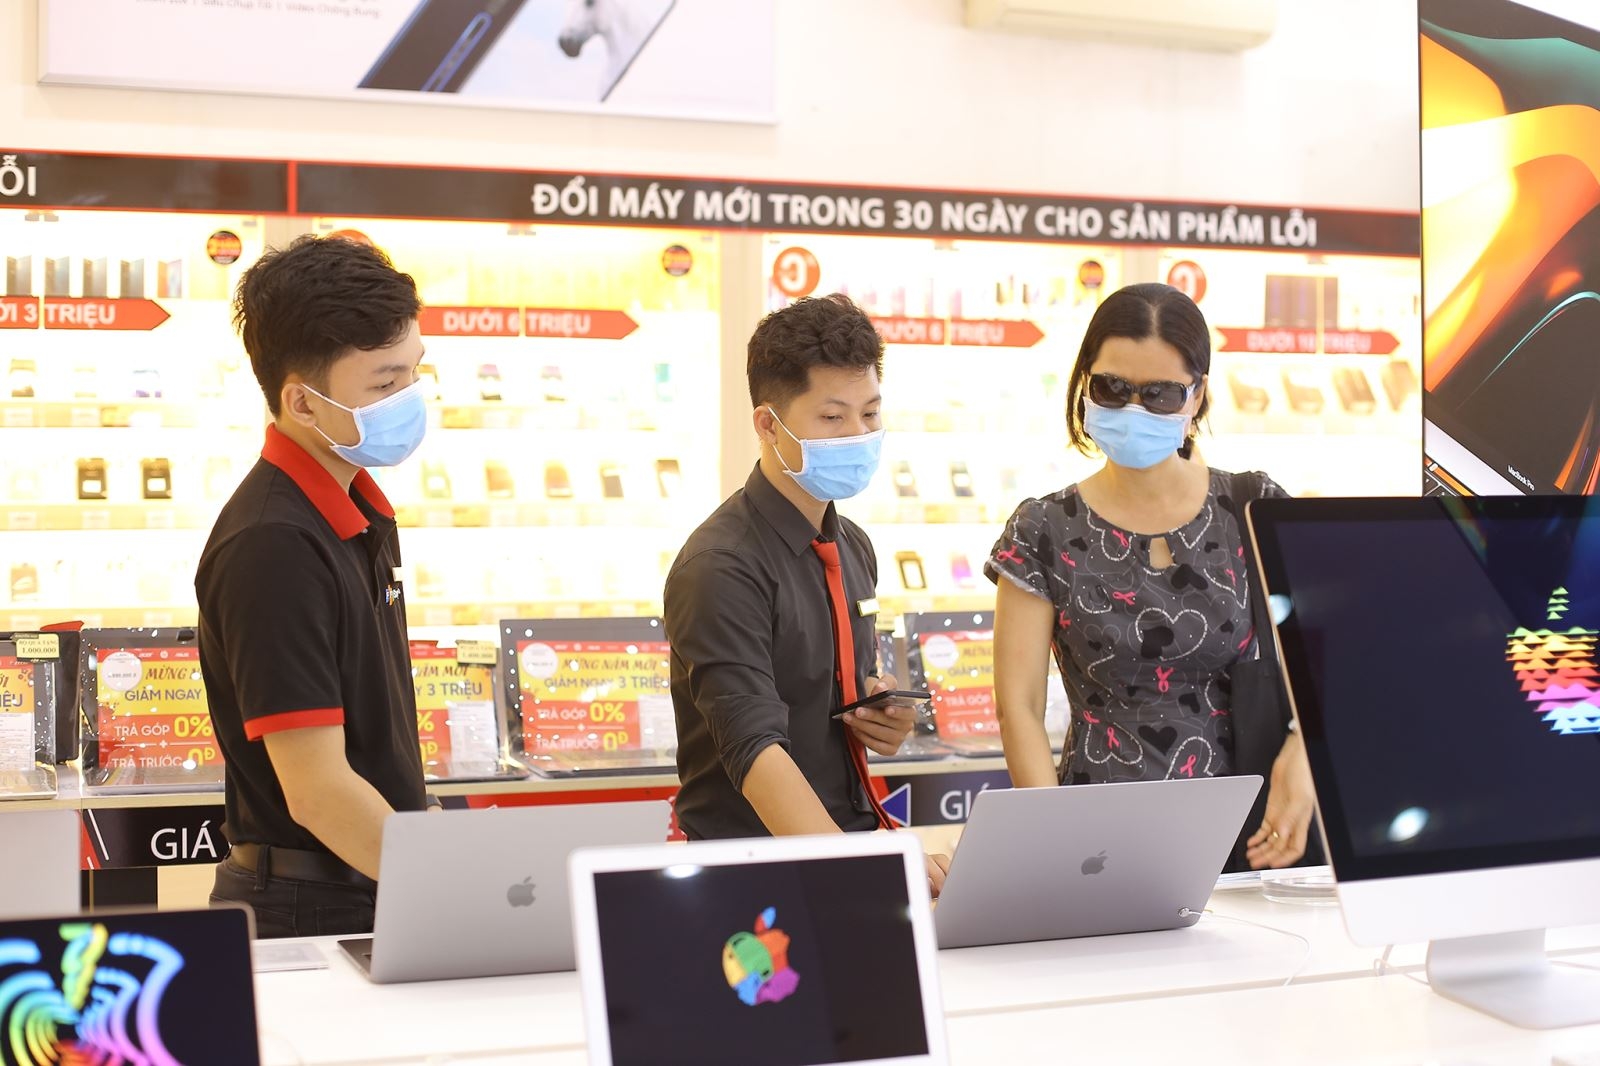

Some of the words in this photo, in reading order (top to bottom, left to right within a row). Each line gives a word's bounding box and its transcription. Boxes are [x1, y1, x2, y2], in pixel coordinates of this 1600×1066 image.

[0, 154, 37, 197] ỖI
[531, 174, 599, 217] ĐỔI
[608, 182, 685, 220] MÁY
[693, 185, 762, 223] MỚI
[767, 193, 886, 229] TRONG
[892, 199, 934, 231] 30
[941, 197, 1029, 235] NGÀY
[1034, 204, 1104, 239] CHO
[1109, 202, 1172, 241] SẢN
[1177, 204, 1265, 245] PHẨM
[1270, 207, 1318, 248] LỖI
[23, 303, 38, 323] 3
[44, 302, 116, 328] TRIỆU
[527, 313, 592, 337] TRIỆU
[145, 665, 188, 680] MỪNG
[544, 674, 577, 689] GIẢM
[619, 677, 627, 689] 3
[125, 686, 161, 701] GIẢM
[164, 688, 202, 701] NGAY
[427, 683, 436, 696] 3
[440, 680, 483, 700] TRIỆU
[560, 706, 587, 720] GÓP
[590, 702, 626, 723] 0%
[114, 722, 139, 736] TRẢ
[141, 722, 170, 736] GÓP
[174, 715, 213, 738] 0%
[111, 753, 136, 768] TRẢ
[139, 754, 183, 768] TRƯỚC
[150, 819, 218, 860] GIÁ
